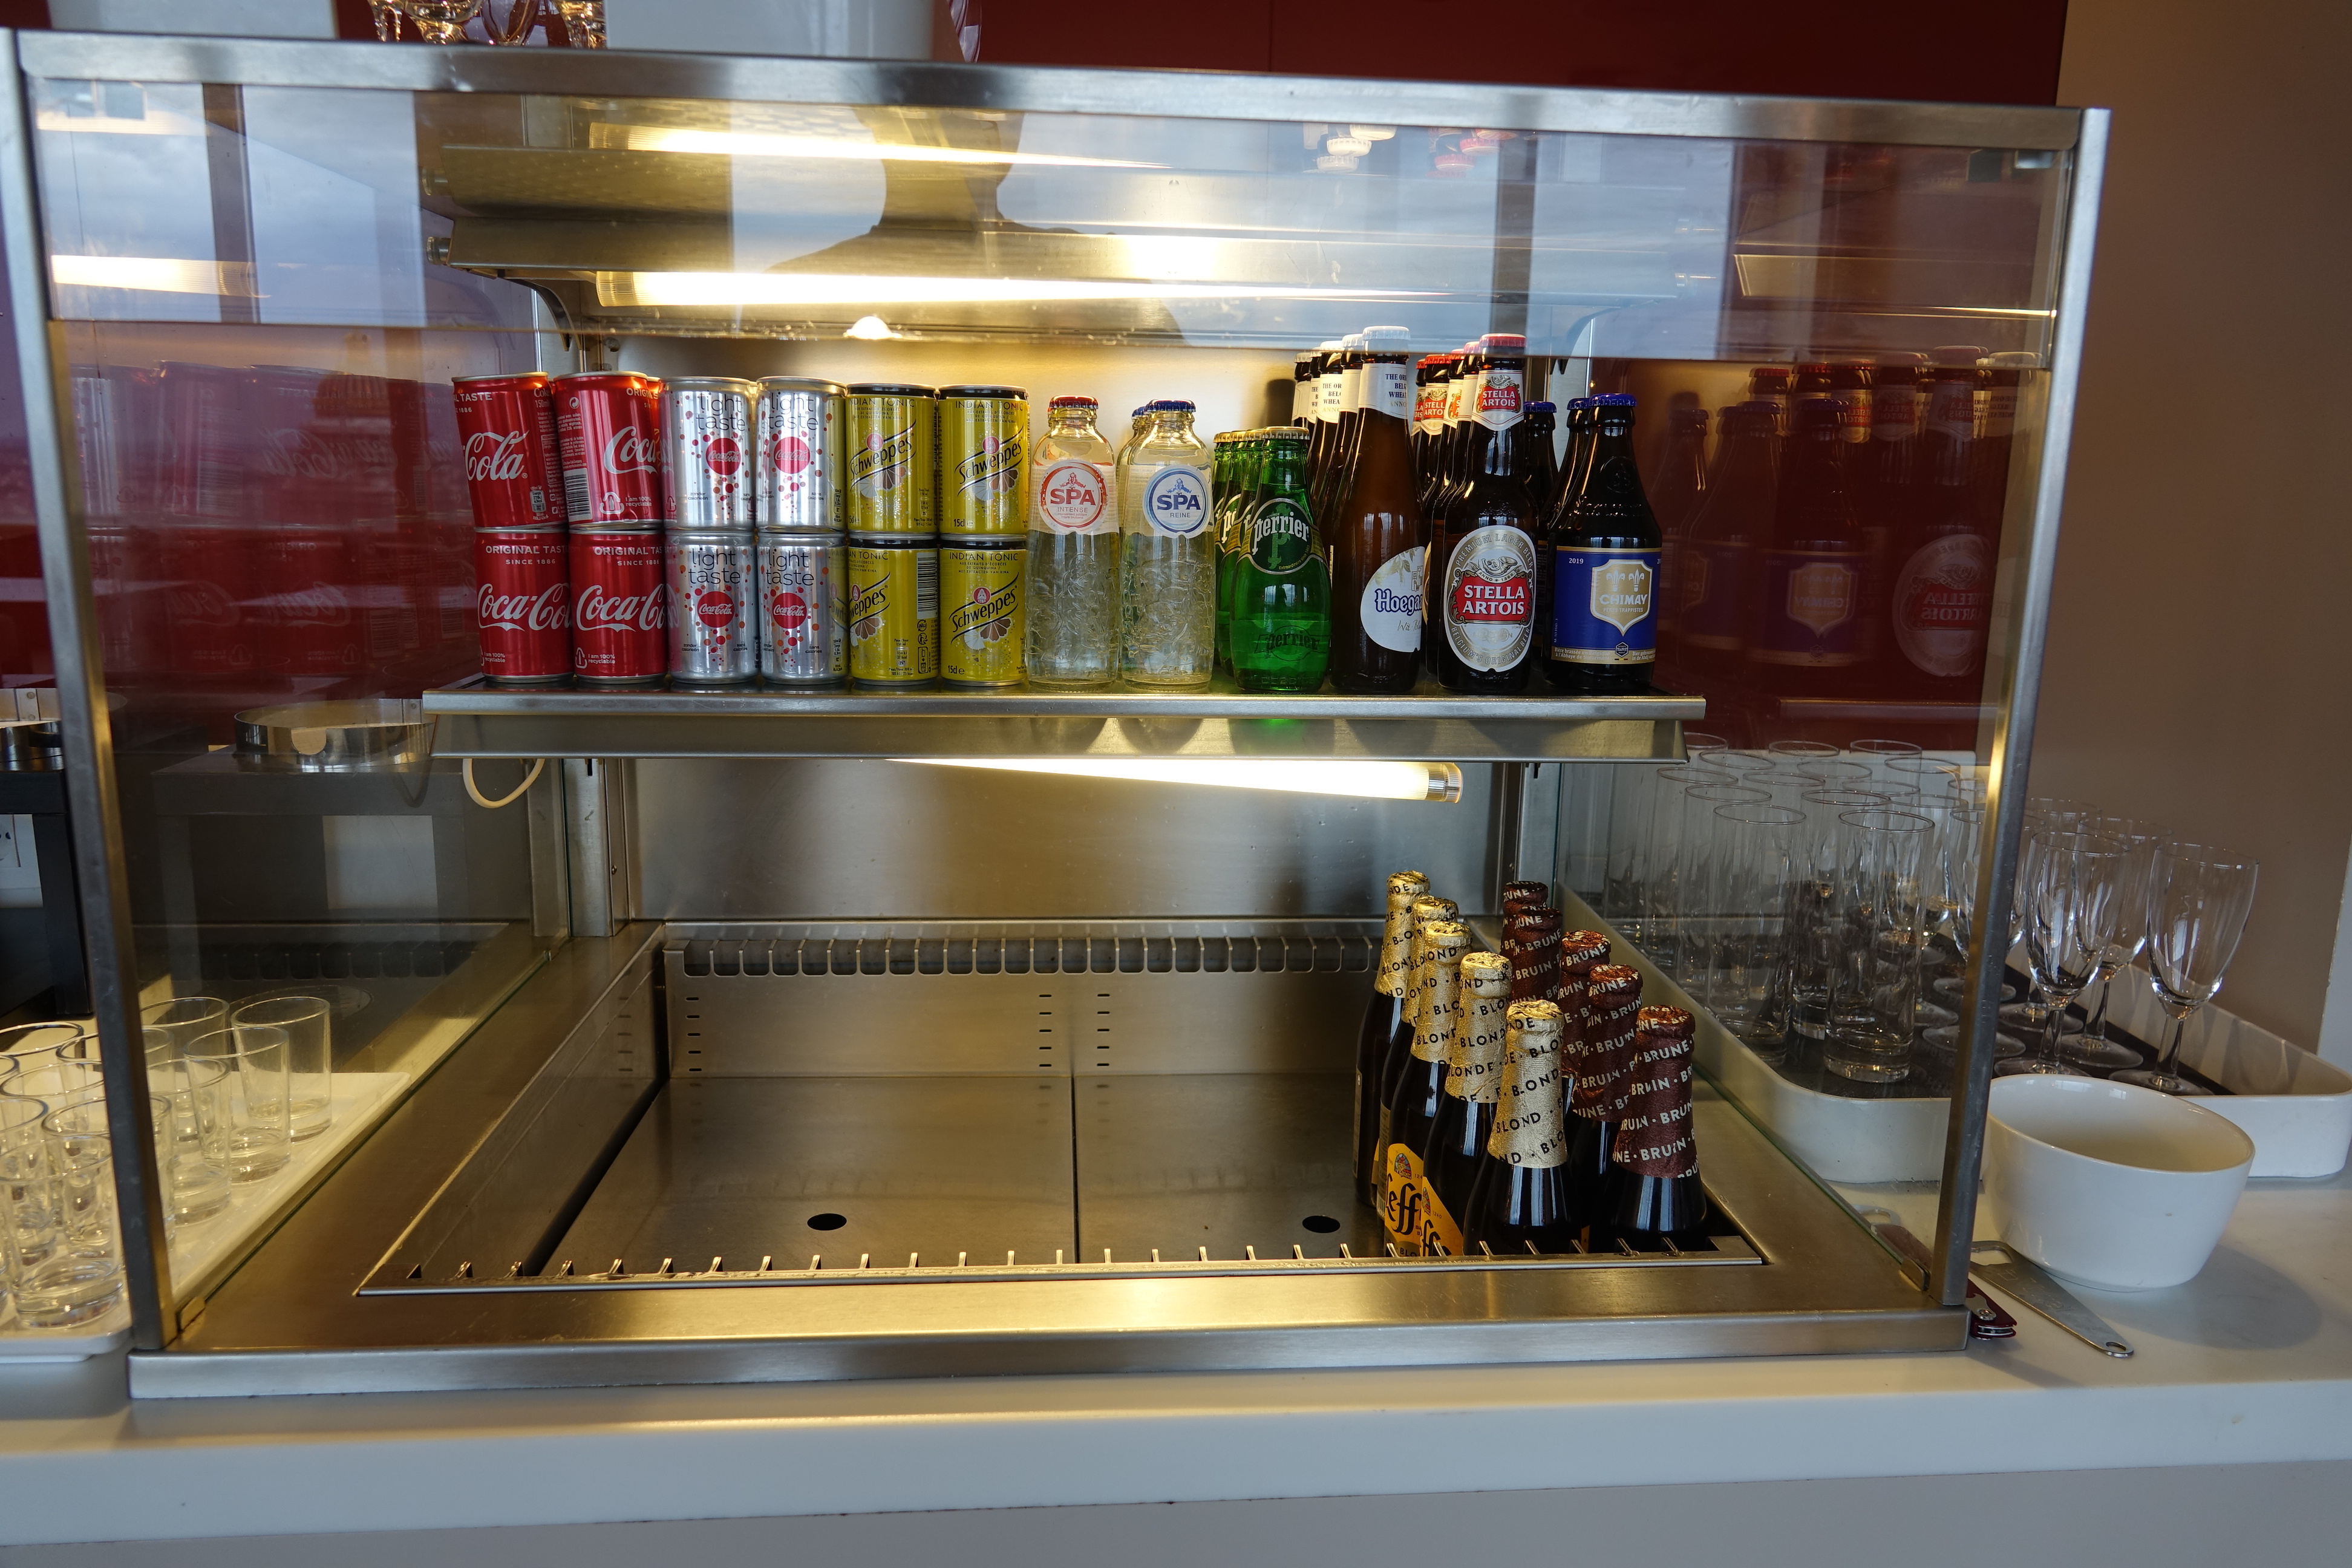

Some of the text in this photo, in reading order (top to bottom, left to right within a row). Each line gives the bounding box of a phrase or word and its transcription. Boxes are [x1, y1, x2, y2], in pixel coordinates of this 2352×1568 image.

[461, 392, 492, 402] TASTE
[701, 390, 742, 416] light
[771, 390, 814, 416] light
[881, 398, 915, 408] TONIC
[956, 400, 1023, 411] INDIAN TONIC
[696, 413, 745, 432] taste
[768, 413, 818, 431] taste
[707, 449, 740, 463] Coca-Cola
[774, 449, 808, 462] Coca-Cola
[850, 436, 912, 481] Schweppes
[959, 439, 1022, 484] Schweppes
[1050, 489, 1096, 506] SPA
[1157, 495, 1201, 511] SPA
[1252, 511, 1309, 555] perrier
[486, 545, 540, 554] ORIGINAL
[594, 547, 648, 555] ORIGINAL
[692, 547, 736, 570] light
[859, 551, 889, 560] TONIC
[949, 552, 1018, 561] INDIAN TONIC
[1455, 533, 1534, 569] PREMIUM LAGER BEER
[768, 547, 809, 572] light
[688, 568, 741, 584] taste
[766, 570, 814, 586] taste
[1478, 572, 1493, 581] ANNO
[1464, 585, 1525, 599] STELLA
[1599, 594, 1648, 605] CHIMAY
[699, 603, 733, 616] Coca-Cola
[774, 604, 805, 617] Coca-Cola
[952, 588, 1016, 633] Schweppes
[1462, 601, 1524, 615] ARTOIS
[1451, 627, 1483, 664] BELGIUM'S
[1485, 646, 1522, 665] ORIGINAL
[1519, 627, 1530, 648] BEER
[948, 665, 958, 674] 15cl
[1526, 929, 1561, 952] BRUNE
[1566, 943, 1606, 967] BRUNE
[1515, 961, 1552, 981] BRUIN
[1588, 977, 1627, 997] BRUNE
[1460, 1028, 1506, 1048] BLOND
[1643, 1040, 1689, 1063] BRUNE
[1582, 1069, 1621, 1088] BRUIN
[1631, 1077, 1670, 1096] BRUIN
[1496, 1112, 1541, 1134] BLOND
[1621, 1116, 1649, 1131] BRUIN
[1641, 1137, 1687, 1161] BRUIN
